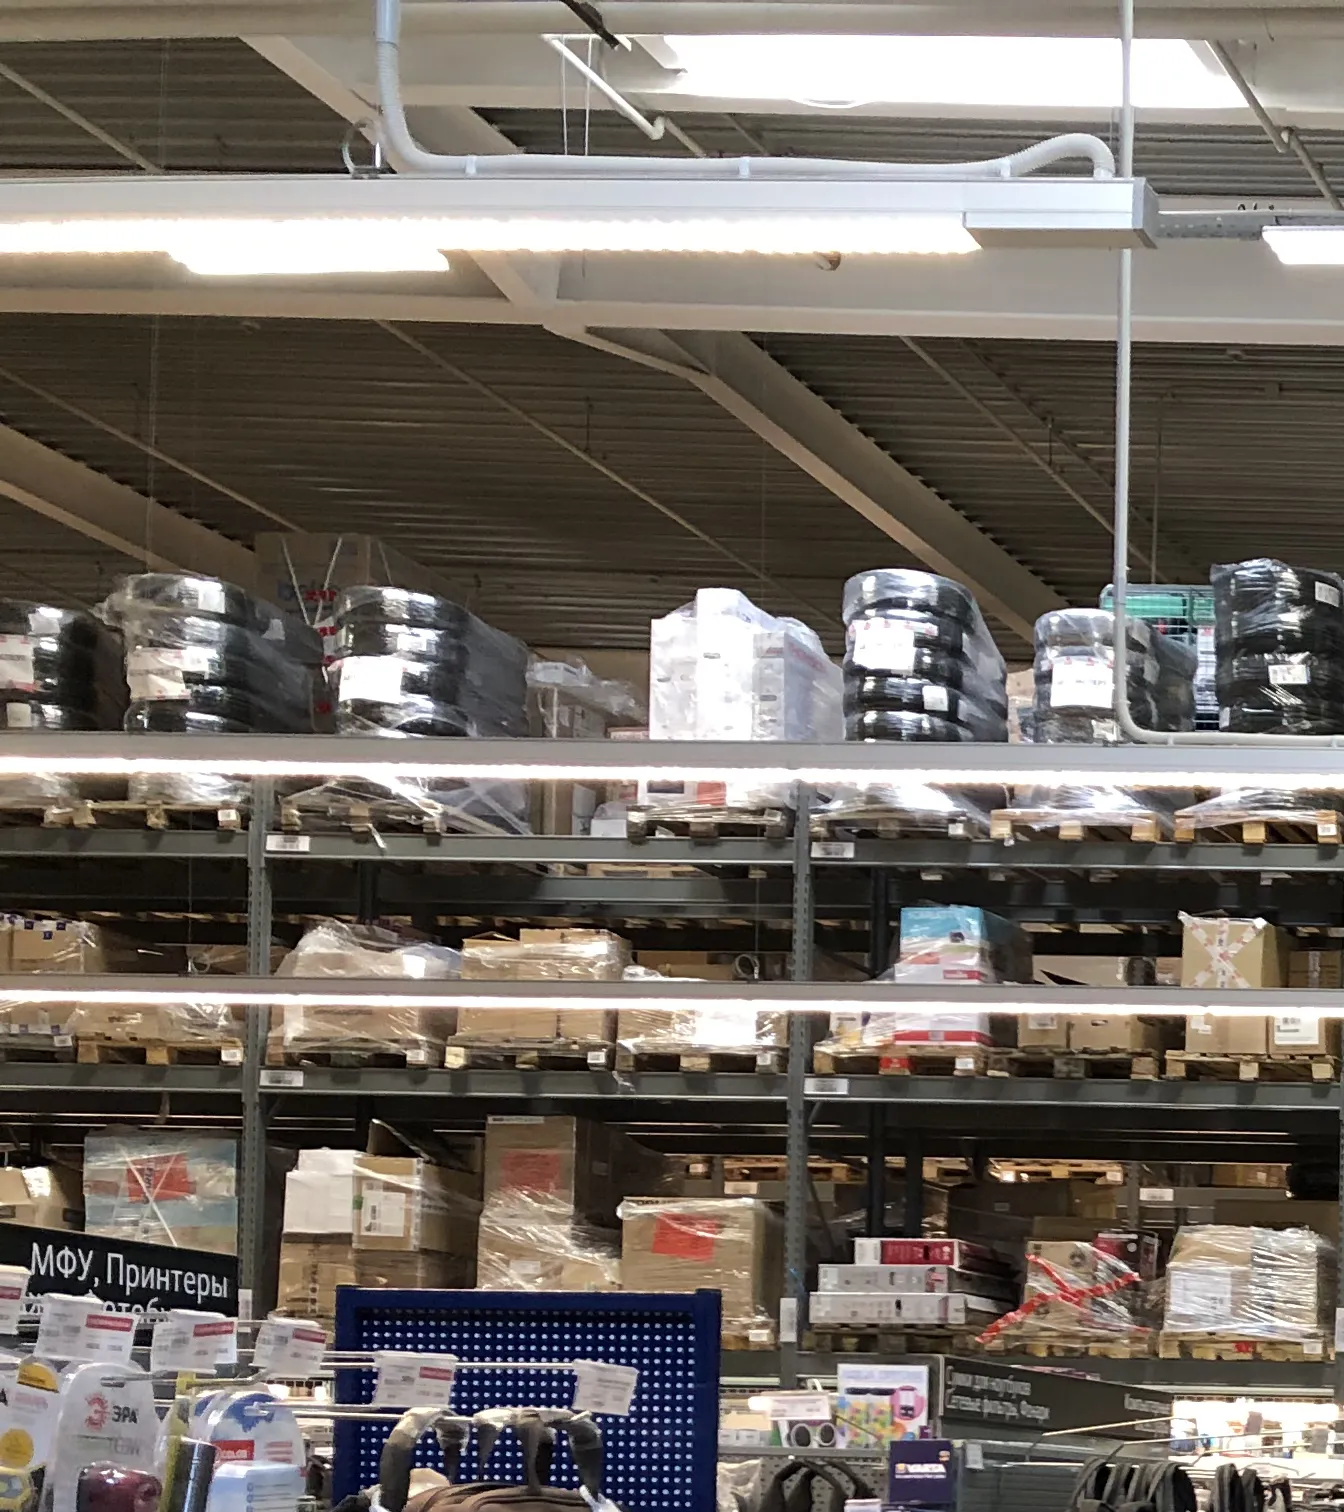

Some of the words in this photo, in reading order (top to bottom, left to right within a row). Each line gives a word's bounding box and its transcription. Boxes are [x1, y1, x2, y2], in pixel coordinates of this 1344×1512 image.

[31, 1242, 99, 1288] МФУ,
[106, 1252, 229, 1304] Принтеры
[112, 1404, 138, 1424] ЭРА
